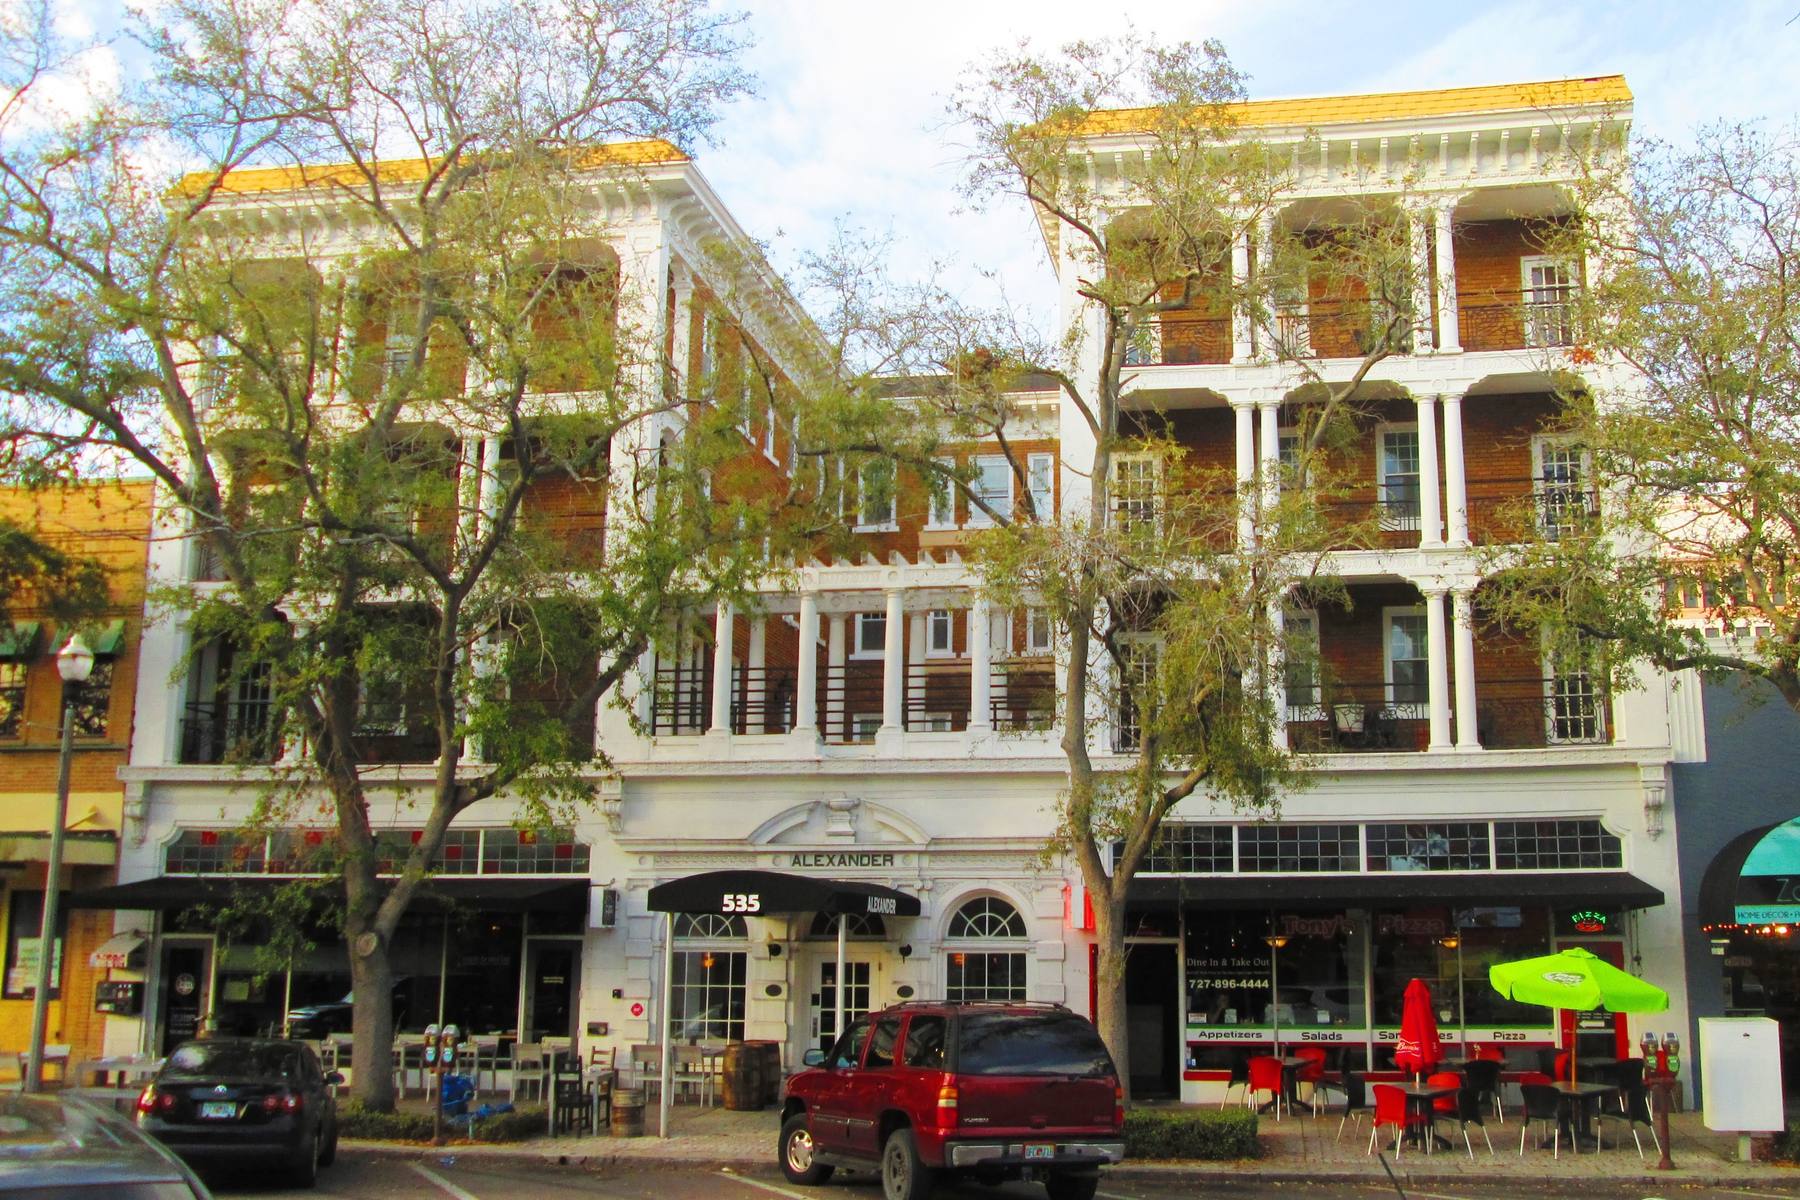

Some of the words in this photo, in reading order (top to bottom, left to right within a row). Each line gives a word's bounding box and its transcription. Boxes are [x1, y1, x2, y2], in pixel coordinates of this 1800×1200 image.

[791, 854, 894, 867] ALEXANDER
[721, 893, 761, 912] 535
[866, 896, 897, 915] ALEXANDER
[1571, 911, 1608, 925] PIZZA
[1737, 911, 1760, 919] HOME
[1761, 911, 1789, 919] DECOR
[1282, 914, 1358, 938] Tony's
[1378, 914, 1446, 935] Pizza
[1186, 957, 1206, 967] Dine
[1210, 958, 1219, 967] In
[1231, 957, 1251, 967] Take
[1253, 958, 1270, 967] Out
[1188, 979, 1270, 989] 727-896-4444
[1198, 1030, 1263, 1040] Appetizers
[1301, 1032, 1343, 1041] Salads
[1492, 1031, 1527, 1041] Pizza
